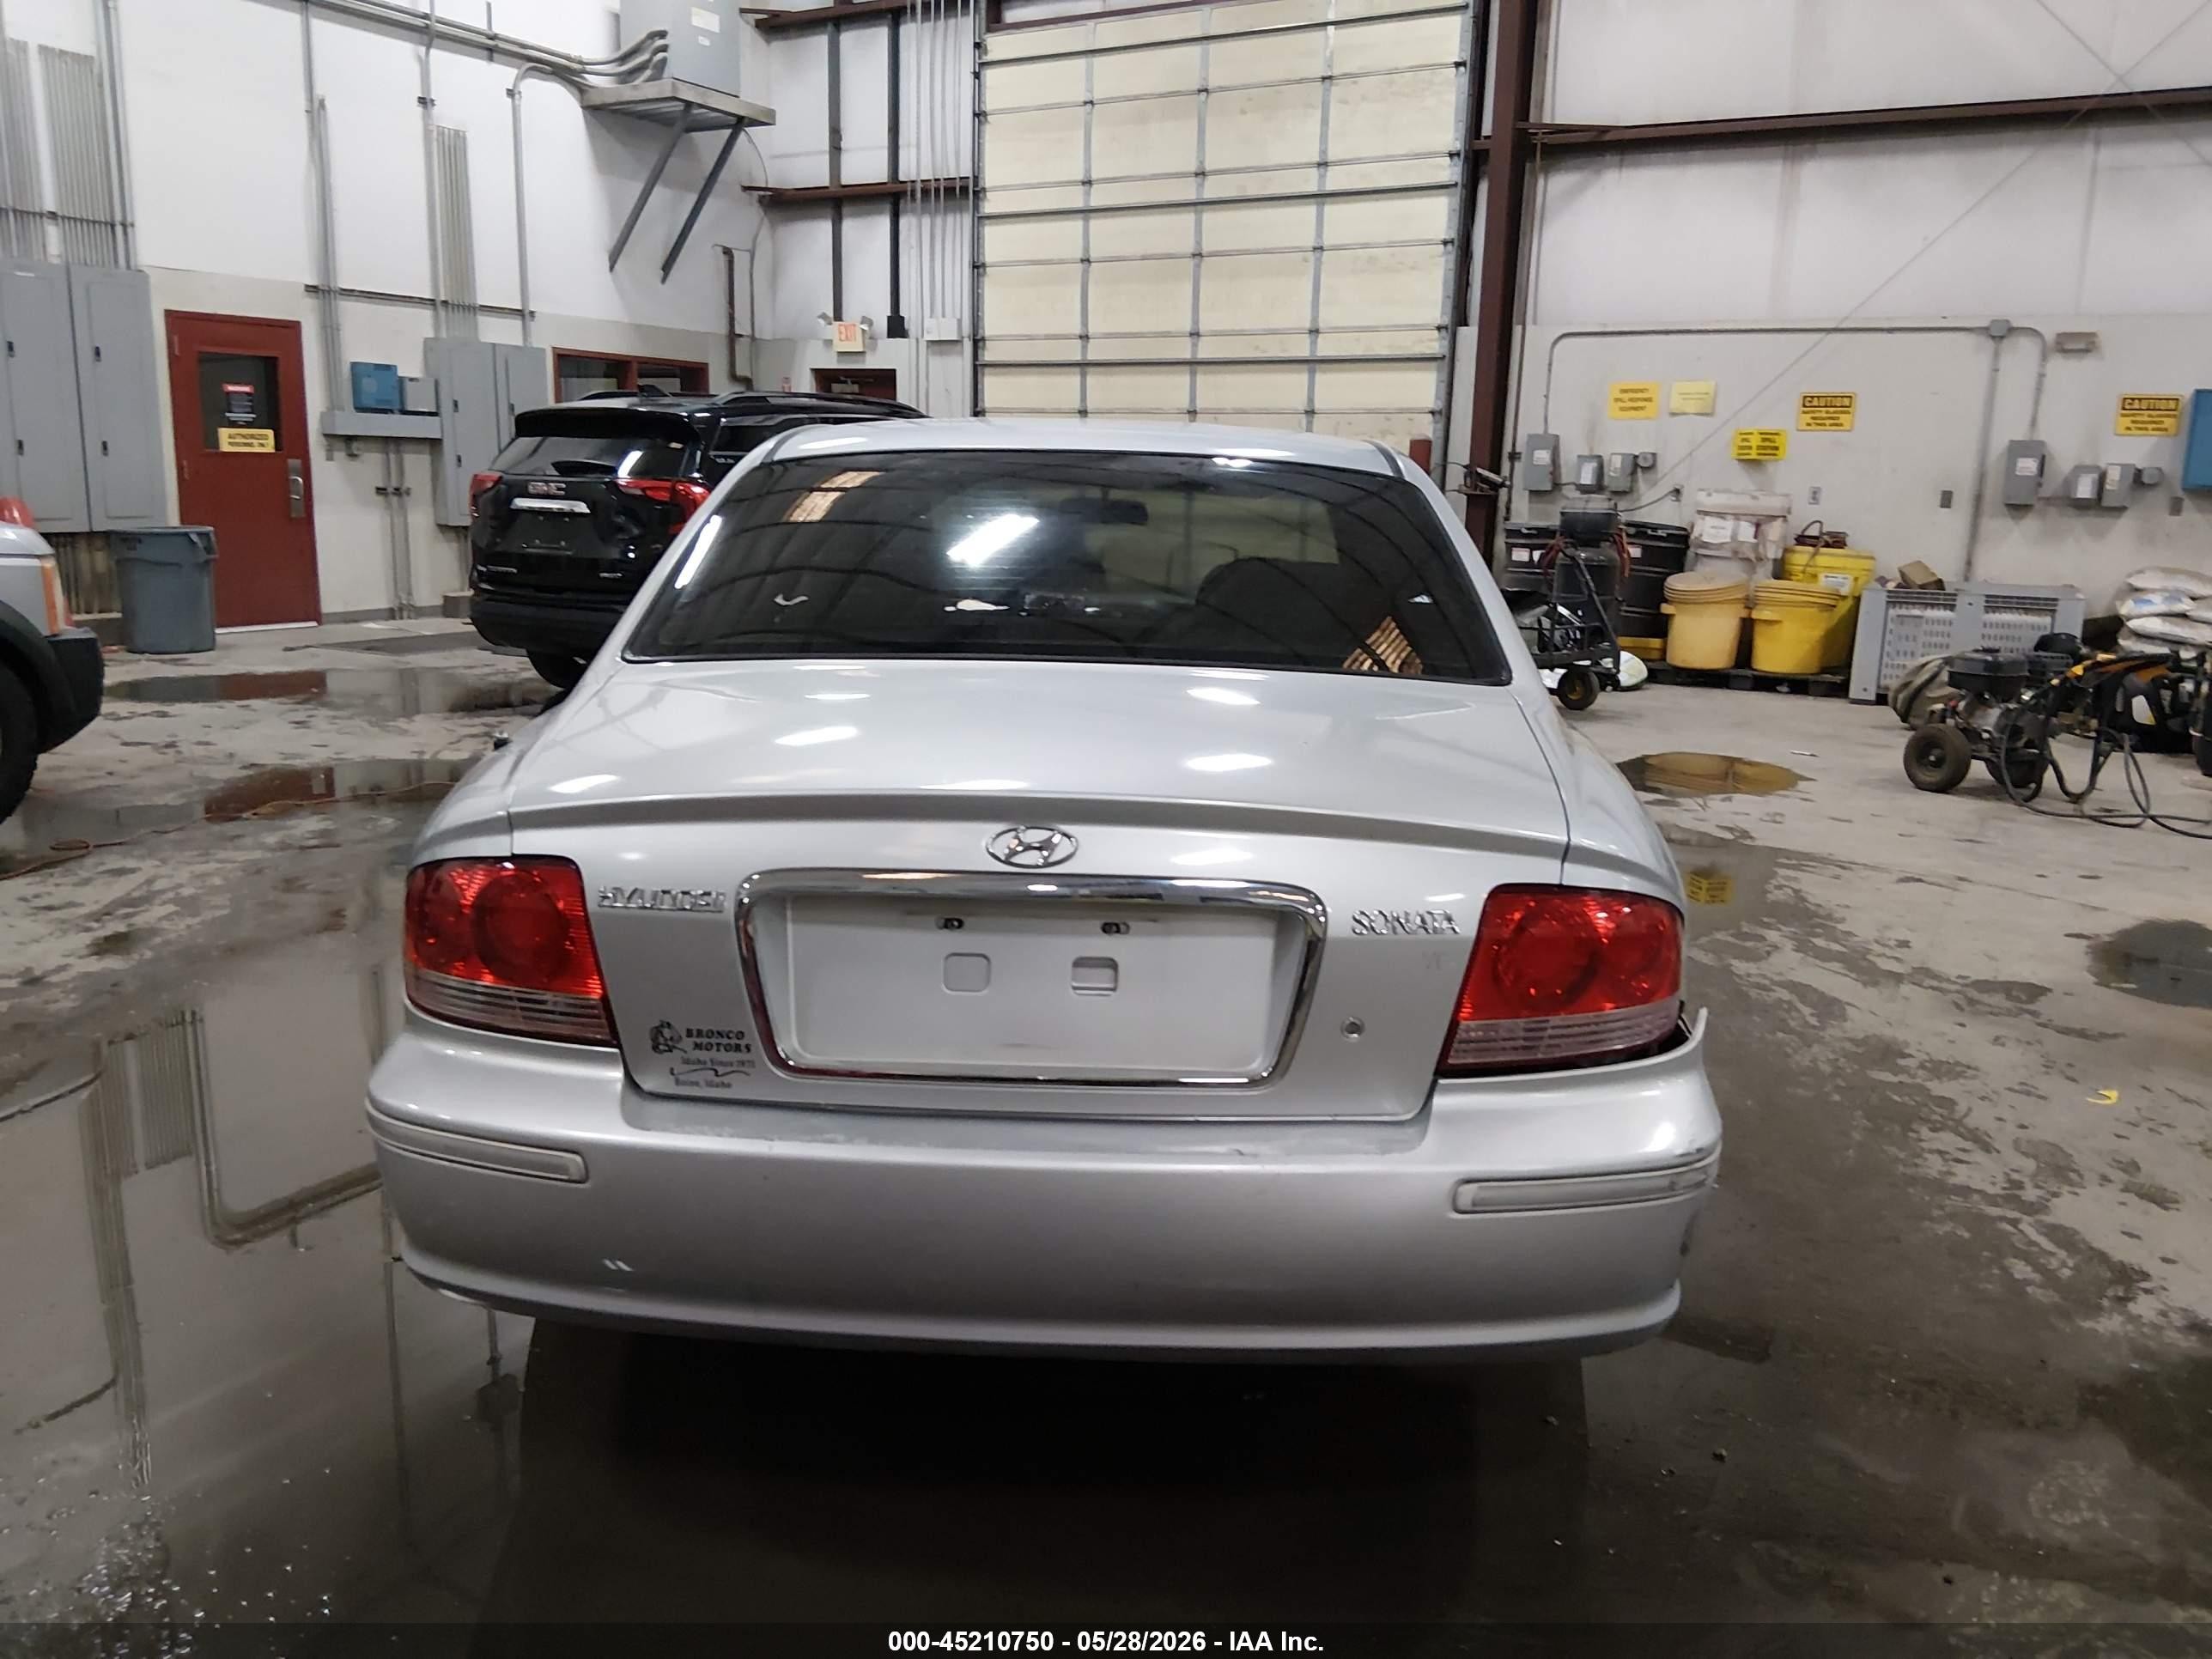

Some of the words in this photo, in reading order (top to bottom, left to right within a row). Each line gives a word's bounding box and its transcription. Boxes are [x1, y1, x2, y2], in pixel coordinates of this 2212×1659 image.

[1804, 397, 1851, 407] CAUTION
[2124, 398, 2178, 410] CAUTION
[1352, 908, 1461, 935] SONATA
[685, 1028, 745, 1041] BRONCO
[692, 1041, 752, 1053] MOTORS
